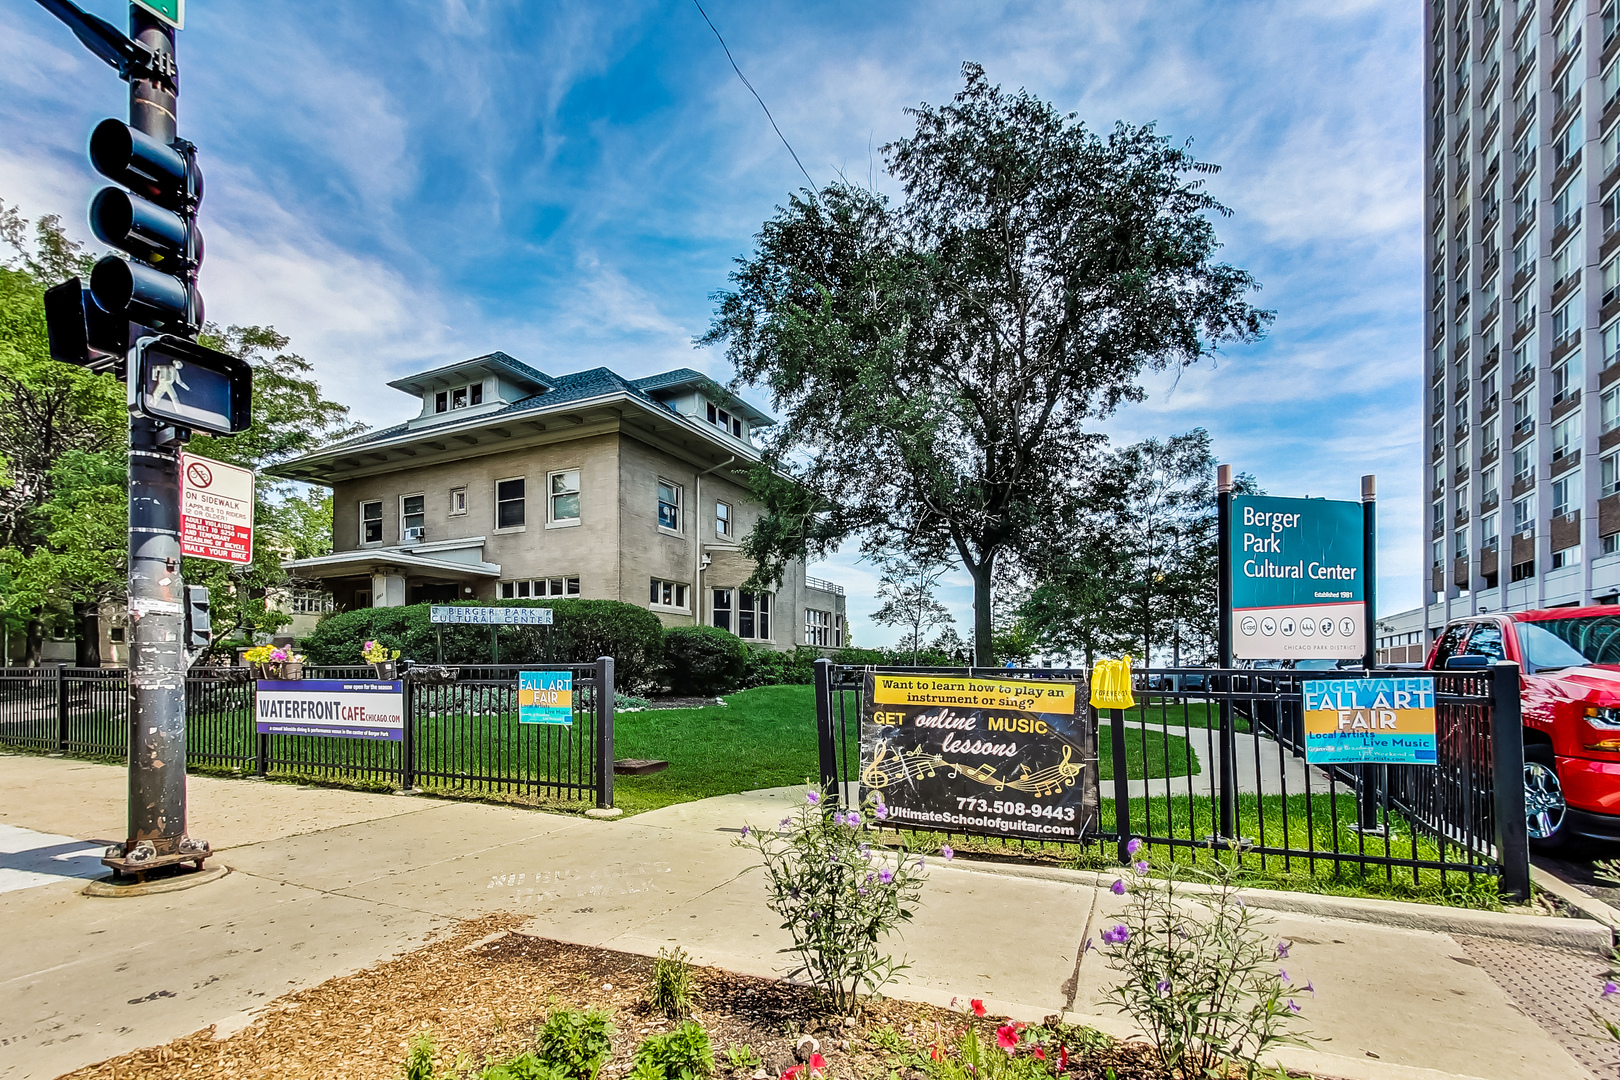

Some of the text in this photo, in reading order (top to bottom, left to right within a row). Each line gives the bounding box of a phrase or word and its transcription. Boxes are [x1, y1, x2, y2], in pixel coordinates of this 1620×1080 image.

[185, 491, 240, 510] ON SIDEWALK
[194, 508, 203, 516] OR
[226, 510, 247, 520] RIDERS
[1243, 506, 1301, 533] Berger
[184, 522, 210, 532] SUBJECT
[237, 532, 249, 540] FINE
[185, 516, 235, 531] ADULT VIOLATORS
[184, 528, 197, 536] AND
[198, 531, 231, 542] TEMPORARY
[184, 535, 213, 545] DISABLING
[225, 542, 246, 551] BICYCLE
[1243, 532, 1281, 553] Park
[184, 543, 247, 560] WALK YOUR BIKE
[1243, 558, 1357, 580] Cultural Center
[431, 615, 552, 624] CULTURAL CENTER
[448, 607, 535, 616] BERGER PARK
[520, 679, 571, 692] FALL ART
[882, 679, 1065, 699] Want to learn how to play an
[1303, 679, 1432, 694] EDGEWATER
[533, 691, 558, 704] FAIR
[906, 692, 1035, 710] instrument or sing?
[1305, 690, 1432, 711] FALL ART
[873, 708, 1048, 734] GET online MUSIC
[1338, 710, 1397, 730] FAIR
[1309, 730, 1376, 739] Local Artists
[1363, 738, 1430, 748] Live Music
[941, 731, 1019, 758] lessons
[956, 797, 1075, 821] 773.508-9443
[889, 805, 1075, 836] UltimateSchoolofguitar.com
